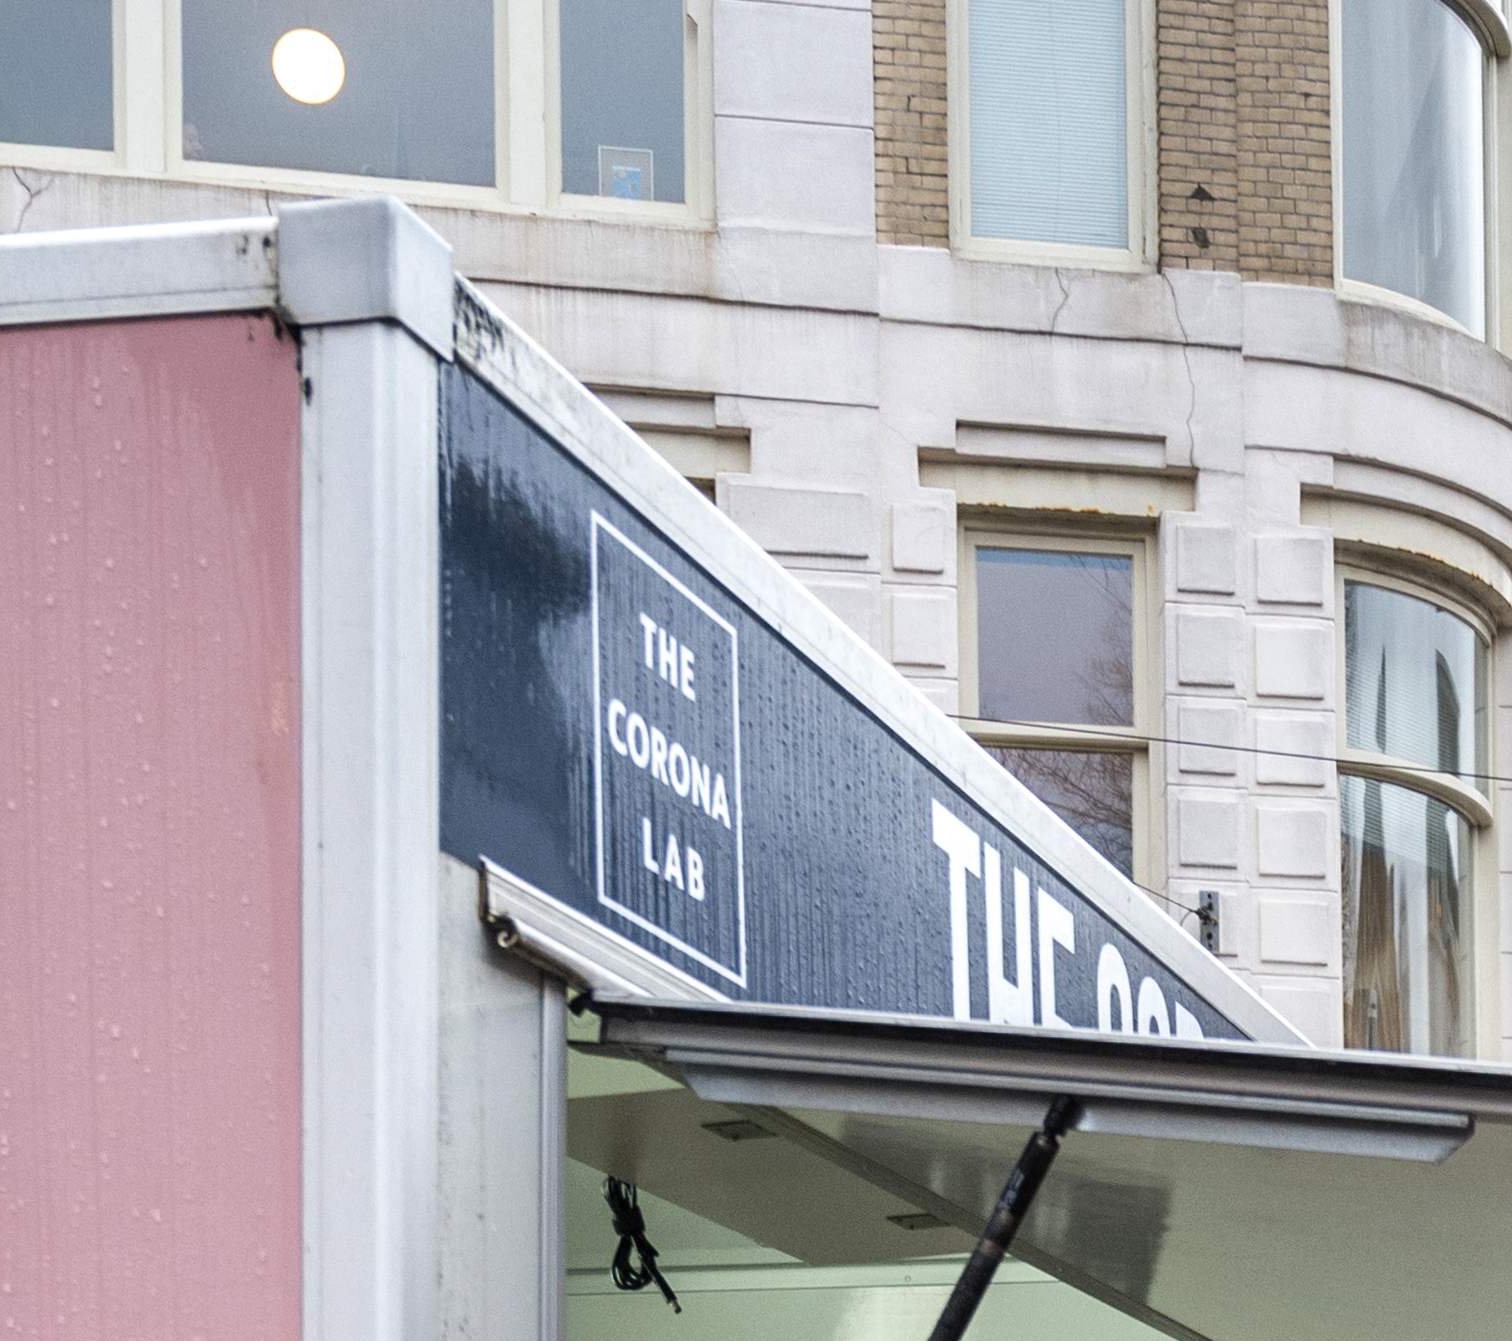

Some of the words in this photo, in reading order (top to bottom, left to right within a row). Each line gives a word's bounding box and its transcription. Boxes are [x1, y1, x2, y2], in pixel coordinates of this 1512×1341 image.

[640, 613, 695, 702] THE
[607, 698, 732, 831] CORONA
[642, 832, 705, 903] LAB
